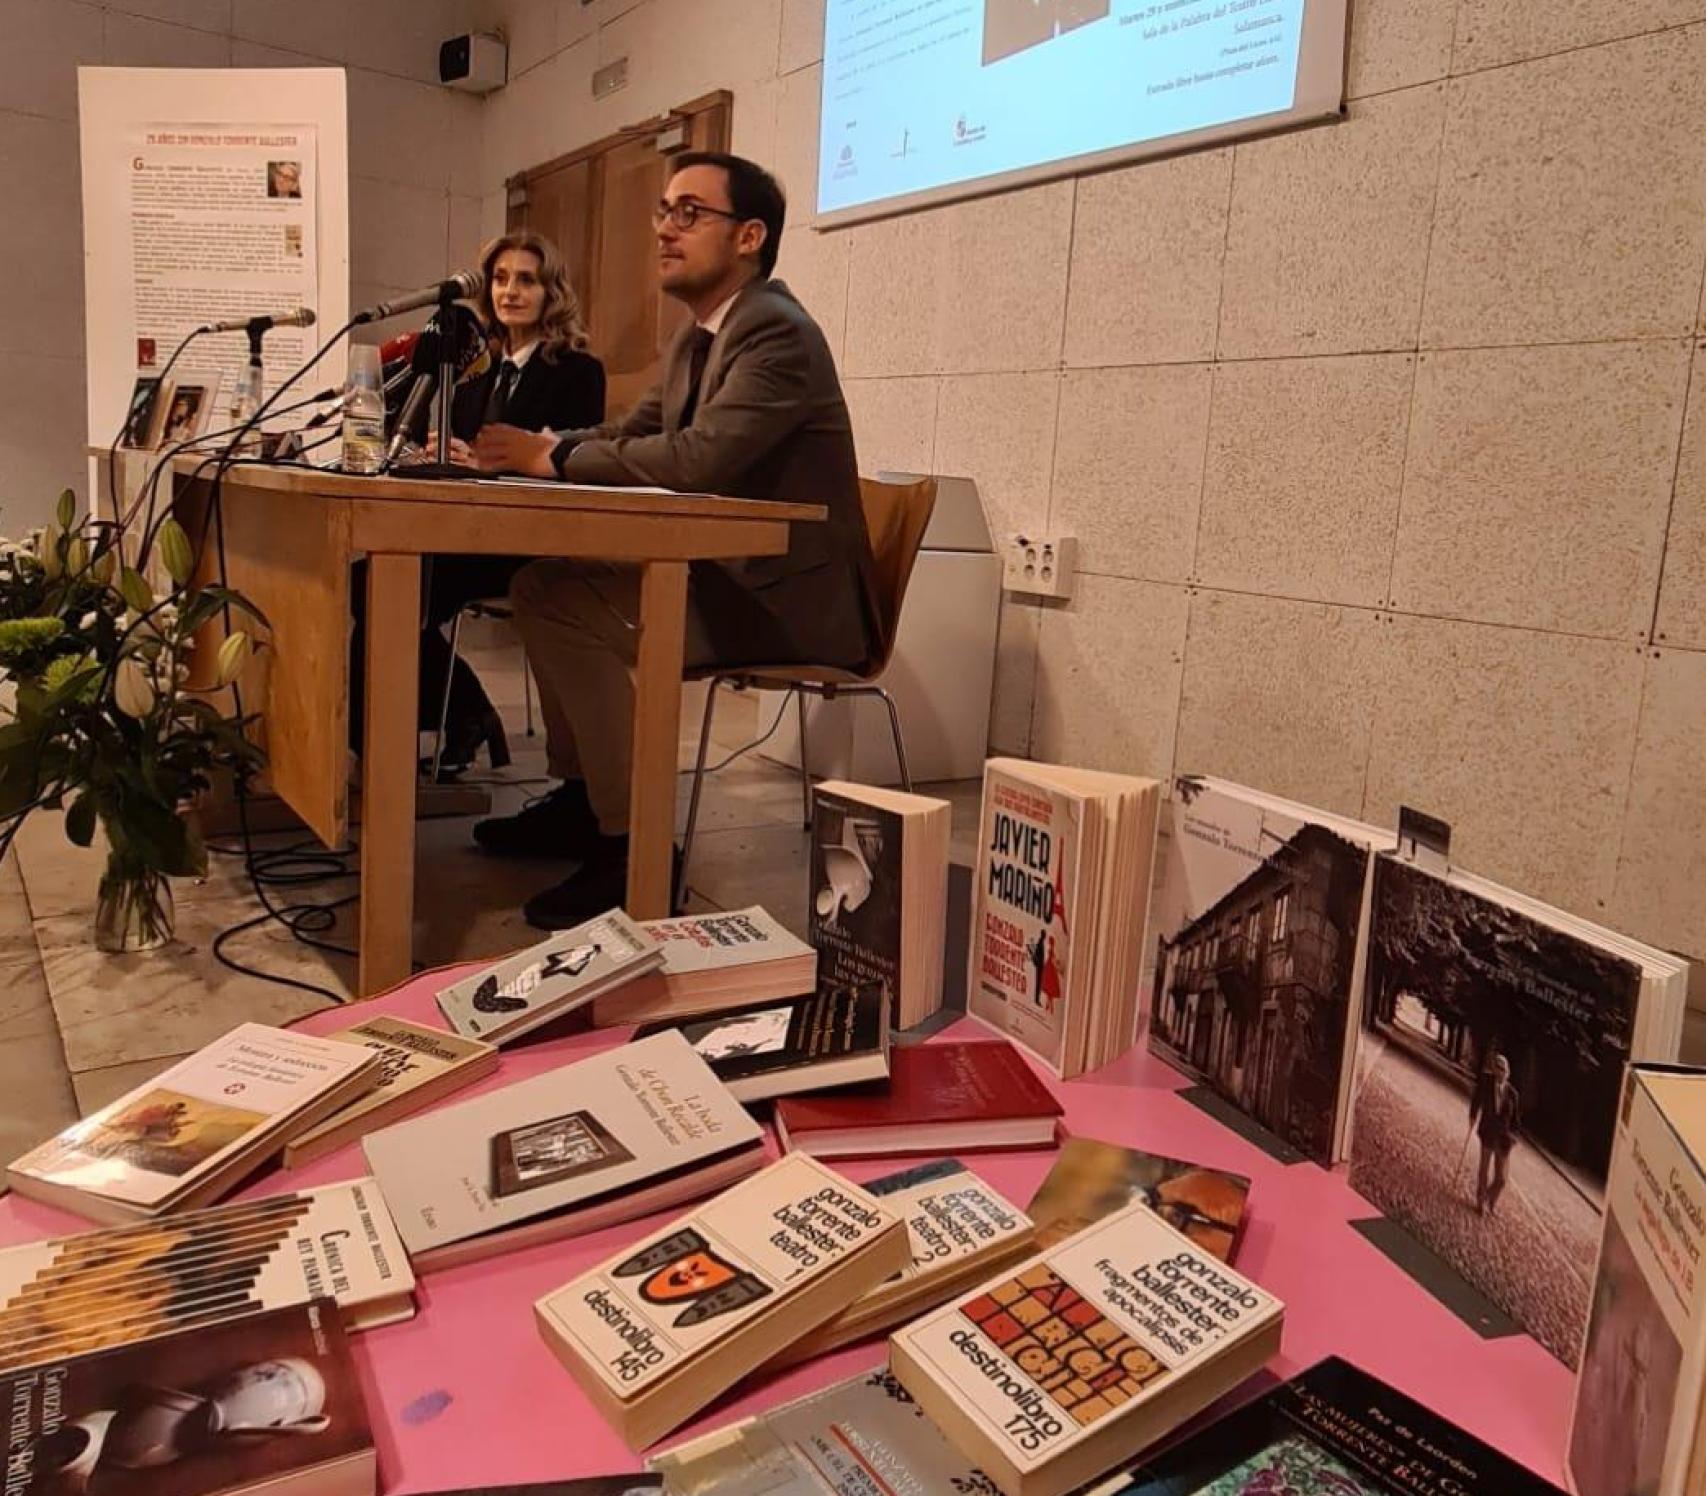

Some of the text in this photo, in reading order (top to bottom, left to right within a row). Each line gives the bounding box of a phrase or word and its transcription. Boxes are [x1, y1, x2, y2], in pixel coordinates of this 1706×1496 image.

[990, 811, 1052, 875] JAVIER
[989, 856, 1055, 924] MARIÑO
[985, 933, 1026, 973] TORRENTE
[986, 912, 1024, 948] GONZALO
[983, 954, 1027, 995] BALLESTER
[773, 1204, 846, 1257] ballester:
[797, 1198, 862, 1241] torrente
[814, 1188, 882, 1228] gonzalo
[918, 1195, 978, 1254] ballester:
[941, 1192, 996, 1239] torrente
[961, 1188, 1017, 1231] gonzalo
[769, 1229, 819, 1266] teatro
[910, 1215, 952, 1257] teatro
[912, 1251, 935, 1267] 2
[332, 1276, 351, 1295] DEL
[370, 1243, 392, 1280] BALLESTER
[1172, 1252, 1259, 1309] gonzalo
[1095, 1258, 1204, 1346] fragmentos de
[1132, 1263, 1228, 1340] ballester:
[1157, 1259, 1240, 1322] torrente
[584, 1288, 665, 1367] destinolibro
[1103, 1288, 1189, 1356] apocalipsis
[610, 1349, 650, 1382] 145
[949, 1329, 1063, 1438] destinolibro
[9, 1371, 39, 1450] Torrente
[42, 1366, 68, 1435] Gonzalo
[1004, 1412, 1050, 1452] 175
[1301, 1406, 1388, 1465] TORRENTE
